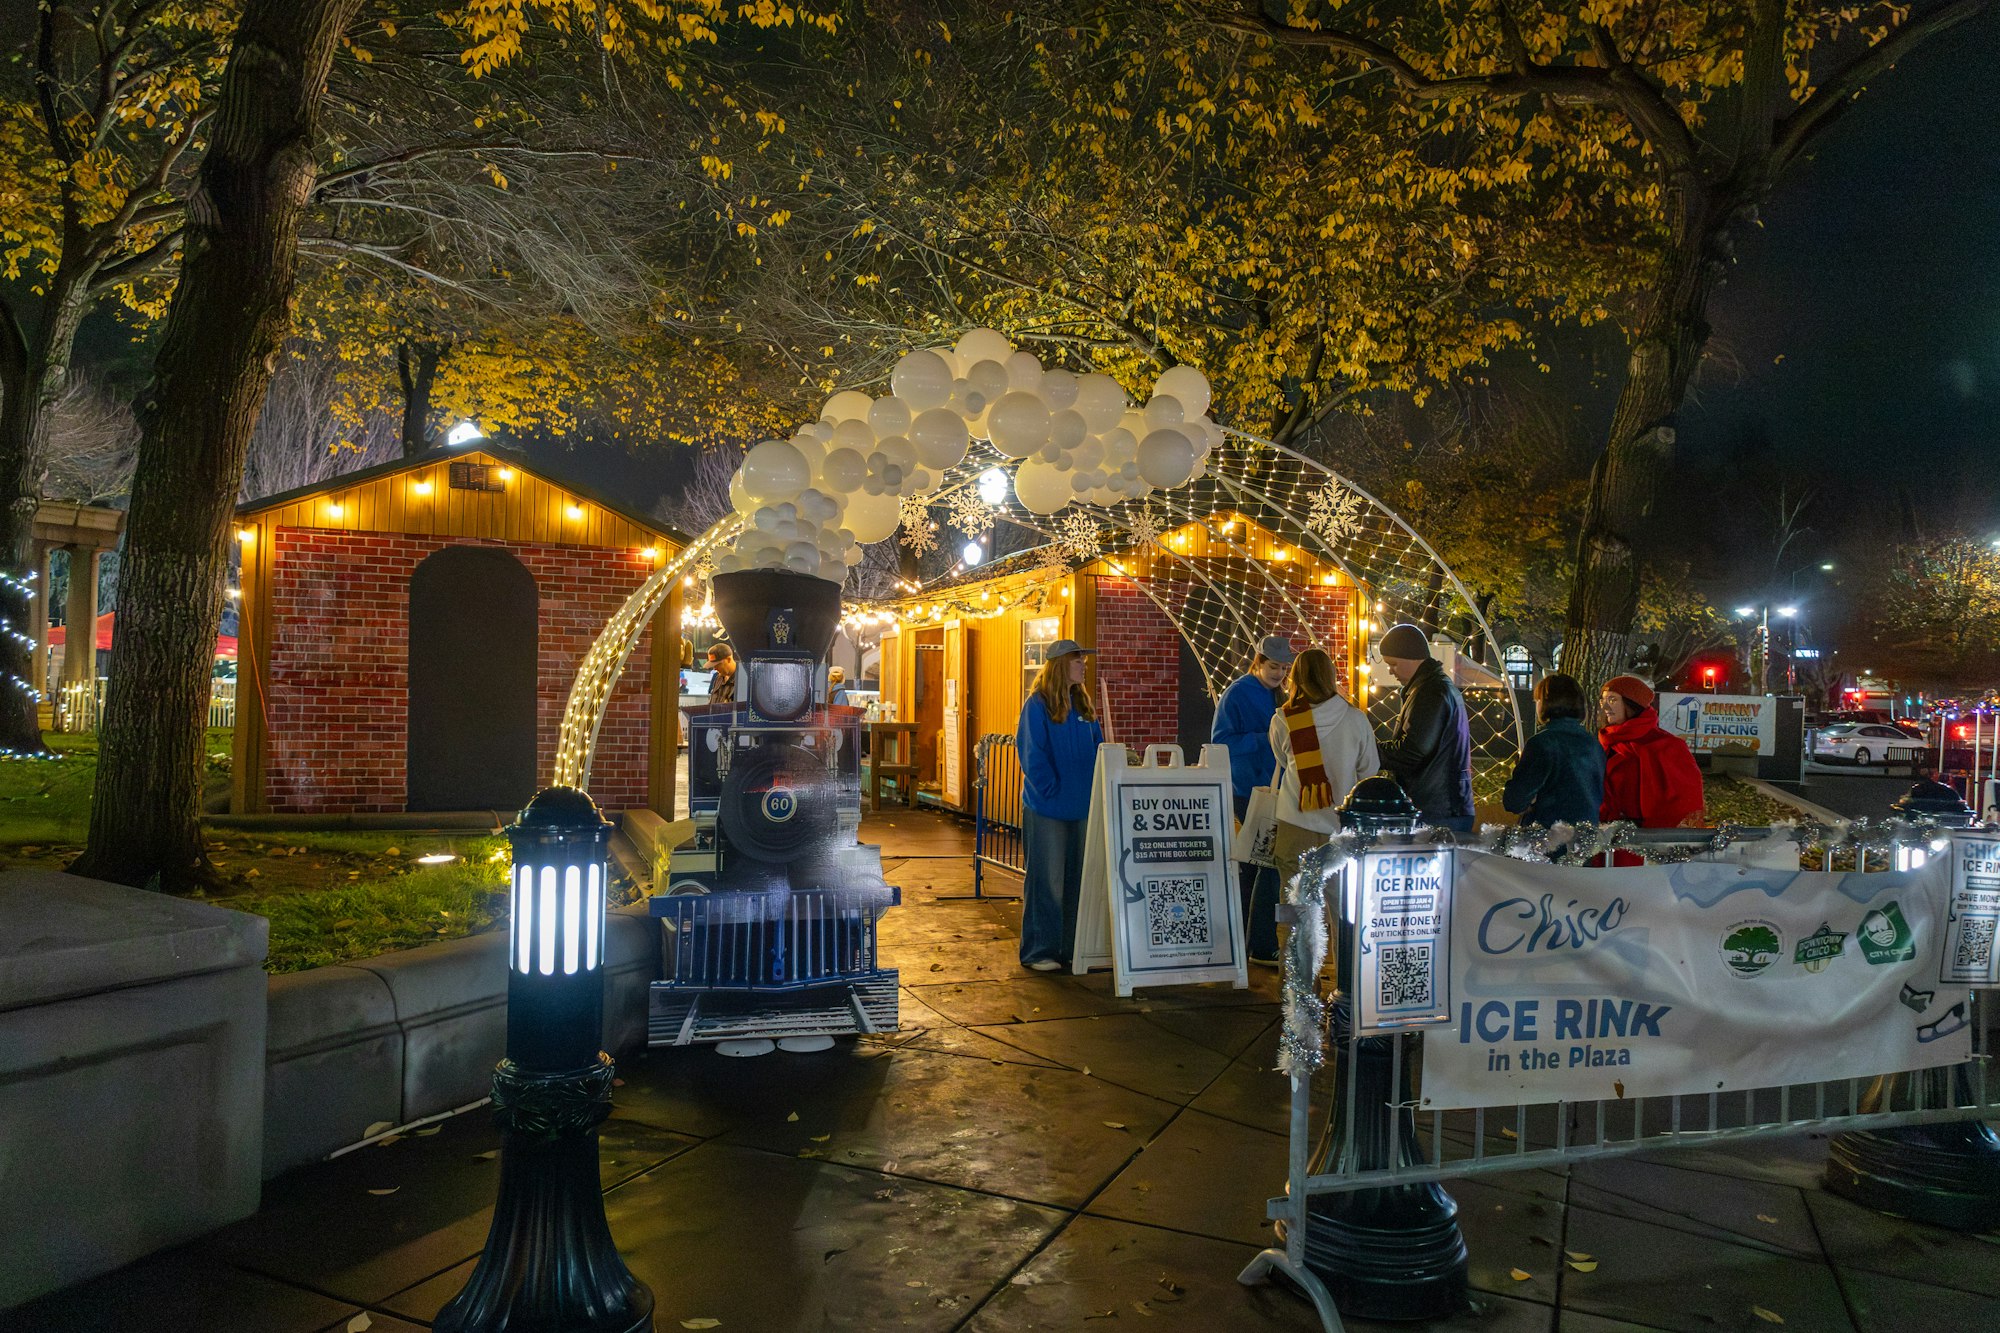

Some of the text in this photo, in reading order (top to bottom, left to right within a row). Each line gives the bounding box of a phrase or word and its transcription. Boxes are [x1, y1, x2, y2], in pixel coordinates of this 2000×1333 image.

[1702, 702, 1761, 716] JOHNNY
[1704, 723, 1758, 736] FENCING
[770, 797, 789, 810] 60
[1132, 798, 1210, 811] BUY ONLINE
[1132, 813, 1210, 831] & SAVE!
[1139, 840, 1207, 850] $12 ONLINE TICKETS
[1965, 842, 2000, 860] CHIC
[1135, 851, 1148, 859] $15
[1158, 850, 1172, 858] THE
[1173, 850, 1187, 858] BOX
[1188, 849, 1212, 858] OFFICE
[1963, 859, 1982, 872] ICE
[1375, 877, 1440, 892] ICE RINK
[1371, 915, 1441, 928] SAVE MONEY!
[1477, 893, 1631, 955] Chico
[1370, 930, 1385, 938] BUY
[1386, 928, 1415, 937] TICKETS
[1799, 935, 1843, 950] DOWNTOWN
[1806, 944, 1830, 958] CHICO
[1869, 950, 1883, 958] CITY
[1459, 998, 1672, 1044] ICE RINK
[1488, 1044, 1631, 1072] in the Plaza
